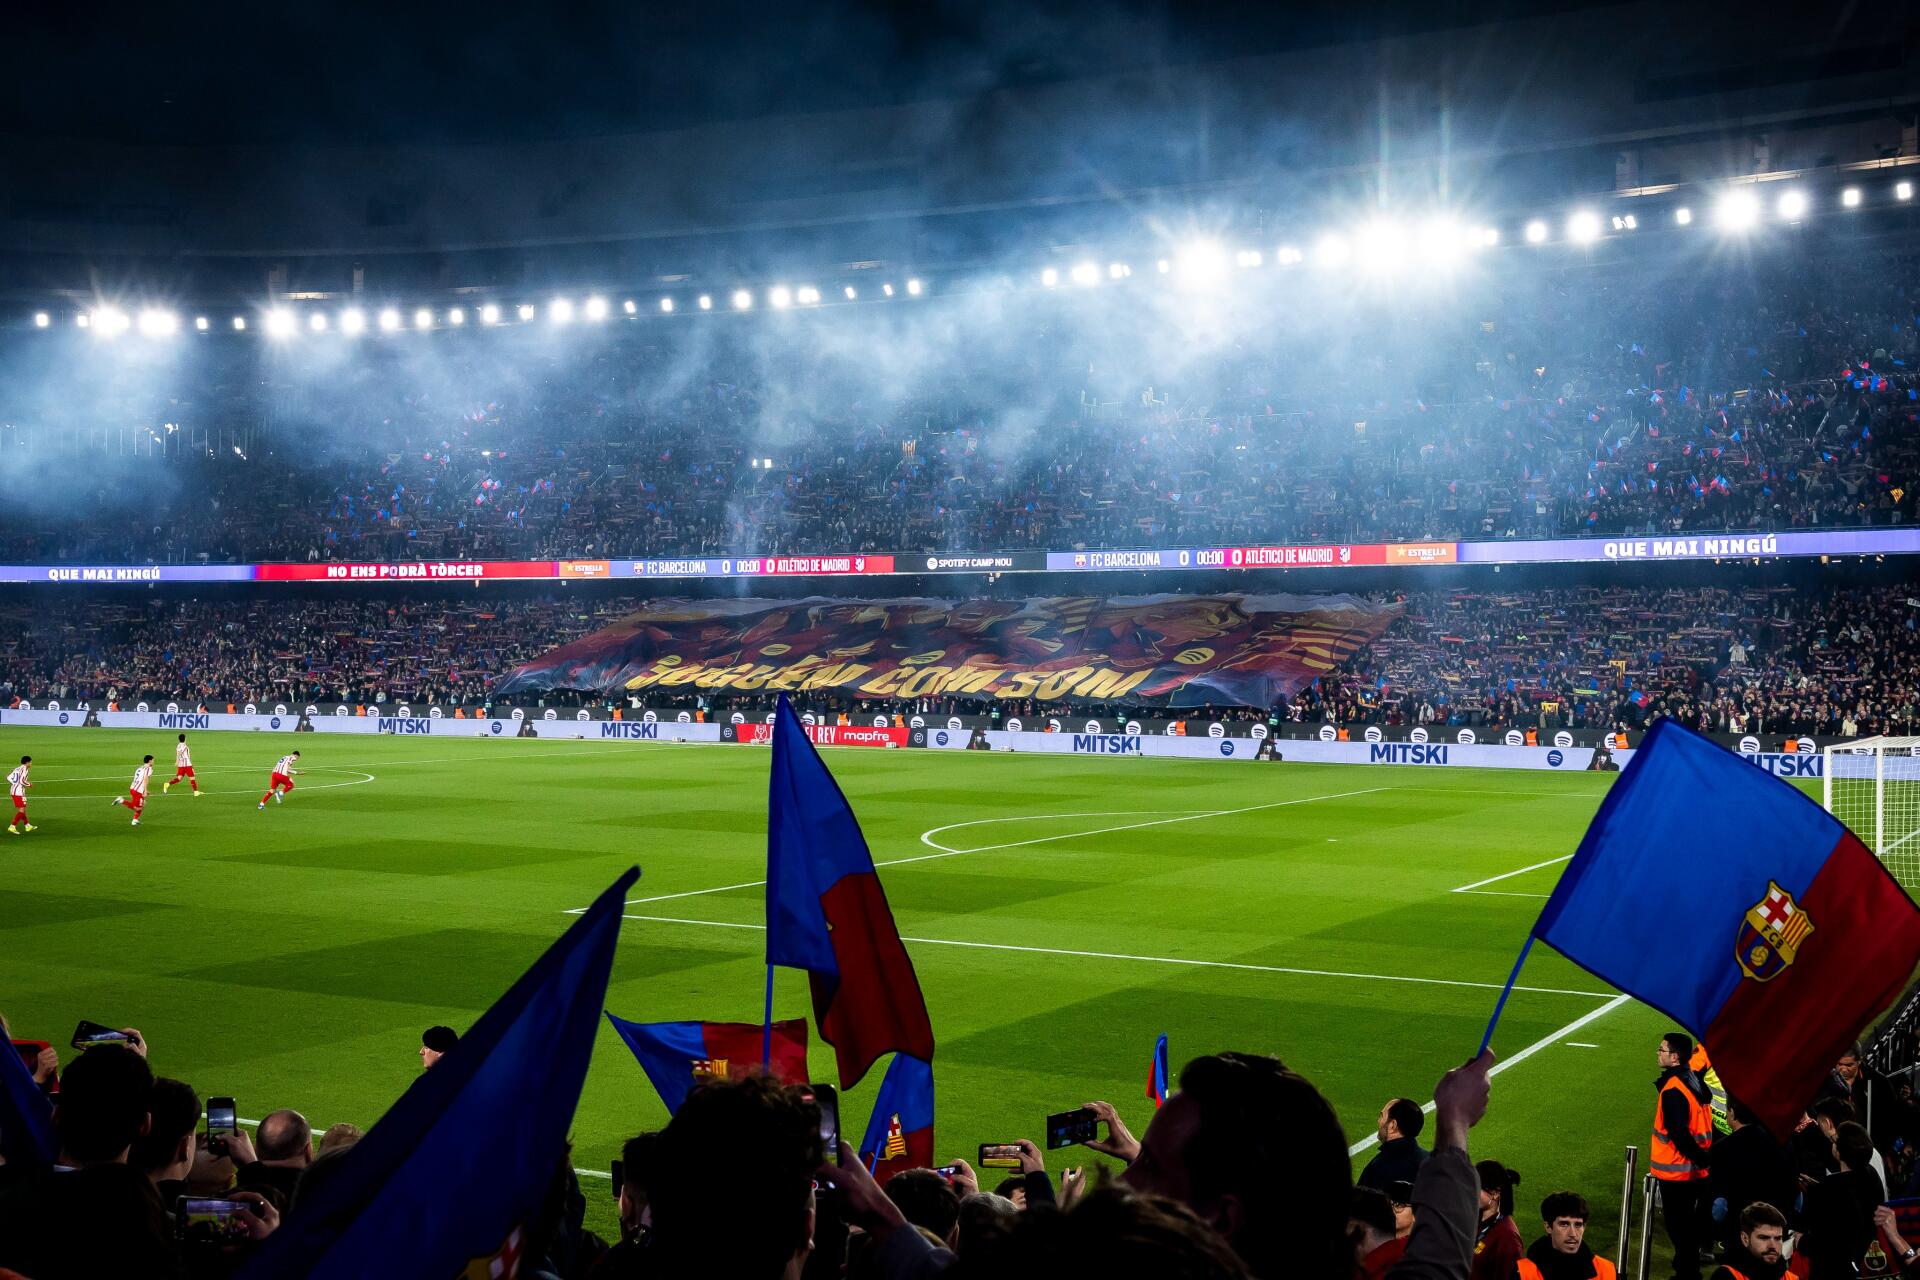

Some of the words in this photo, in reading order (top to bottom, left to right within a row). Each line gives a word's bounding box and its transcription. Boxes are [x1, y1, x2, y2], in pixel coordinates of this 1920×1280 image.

[1408, 548, 1447, 557] ESTRELLA
[1604, 541, 1647, 559] QUE
[1653, 539, 1698, 556] MAI
[1704, 533, 1777, 555] NINGÚ
[938, 558, 970, 568] SPOTIFY
[971, 558, 994, 567] CAMP
[995, 558, 1012, 567] NOU
[1090, 553, 1103, 567] FC
[1104, 552, 1160, 567] BARCELONA
[1180, 550, 1189, 566] 0
[1196, 550, 1224, 565] 00:00
[1232, 549, 1242, 565] 0
[1245, 547, 1284, 565] ATLÉTICO
[1286, 548, 1297, 564] DE
[1298, 548, 1333, 564] MADRID
[48, 568, 79, 582] QUE
[83, 568, 113, 580] MAI
[116, 565, 161, 580] NINGÚ
[327, 566, 348, 578] NO
[350, 565, 377, 577] ENS
[380, 563, 427, 577] PODRÀ
[430, 562, 484, 577] TÒRCER
[647, 562, 658, 574] FC
[658, 560, 706, 574] BARCELONA
[722, 560, 731, 574] 0
[736, 560, 760, 573] 00:00
[766, 560, 776, 574] 0
[777, 558, 810, 573] ATLÉTICO
[811, 559, 821, 572] DE
[821, 558, 850, 572] MADRID
[994, 666, 1154, 700] SOM
[158, 714, 210, 729] MITSKI
[378, 718, 431, 734] MITSKI
[601, 722, 658, 739] MITSKI
[817, 727, 836, 744] REY
[844, 730, 890, 744] mapfre
[1073, 735, 1141, 754] MITSKI
[1370, 743, 1448, 765] MITSKI
[1761, 924, 1784, 950] FCB
